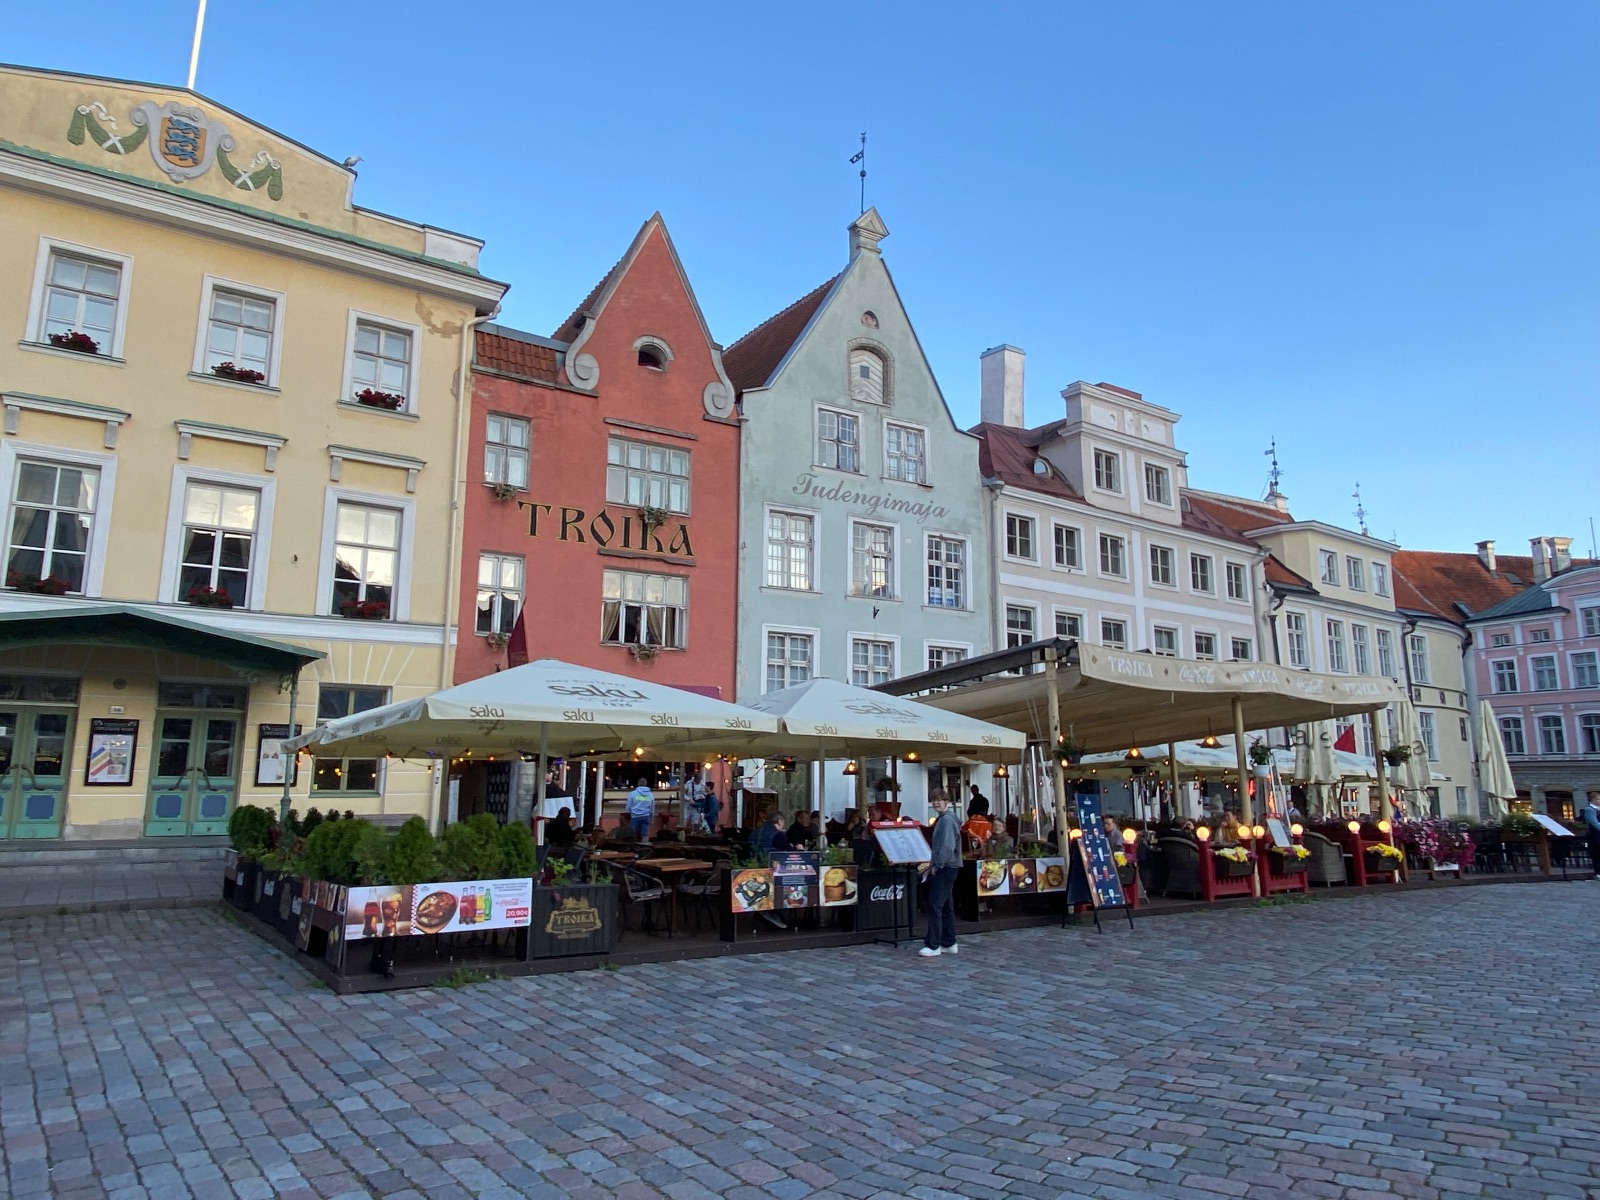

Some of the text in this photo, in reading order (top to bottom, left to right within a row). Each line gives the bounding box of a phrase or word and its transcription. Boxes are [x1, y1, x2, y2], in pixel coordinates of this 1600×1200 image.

[793, 473, 949, 524] Tudengimaja
[517, 500, 696, 557] TROIKA
[1107, 655, 1154, 678] TROIKA
[547, 684, 651, 700] saku
[470, 704, 505, 718] saku
[563, 708, 595, 722] saku
[845, 702, 922, 718] saku
[650, 713, 679, 726] saku
[726, 717, 752, 729] saku
[814, 724, 838, 735] saku
[876, 727, 898, 738] saku
[928, 730, 949, 742] saku
[981, 734, 1002, 745] saku
[555, 914, 594, 925] TROIKA
